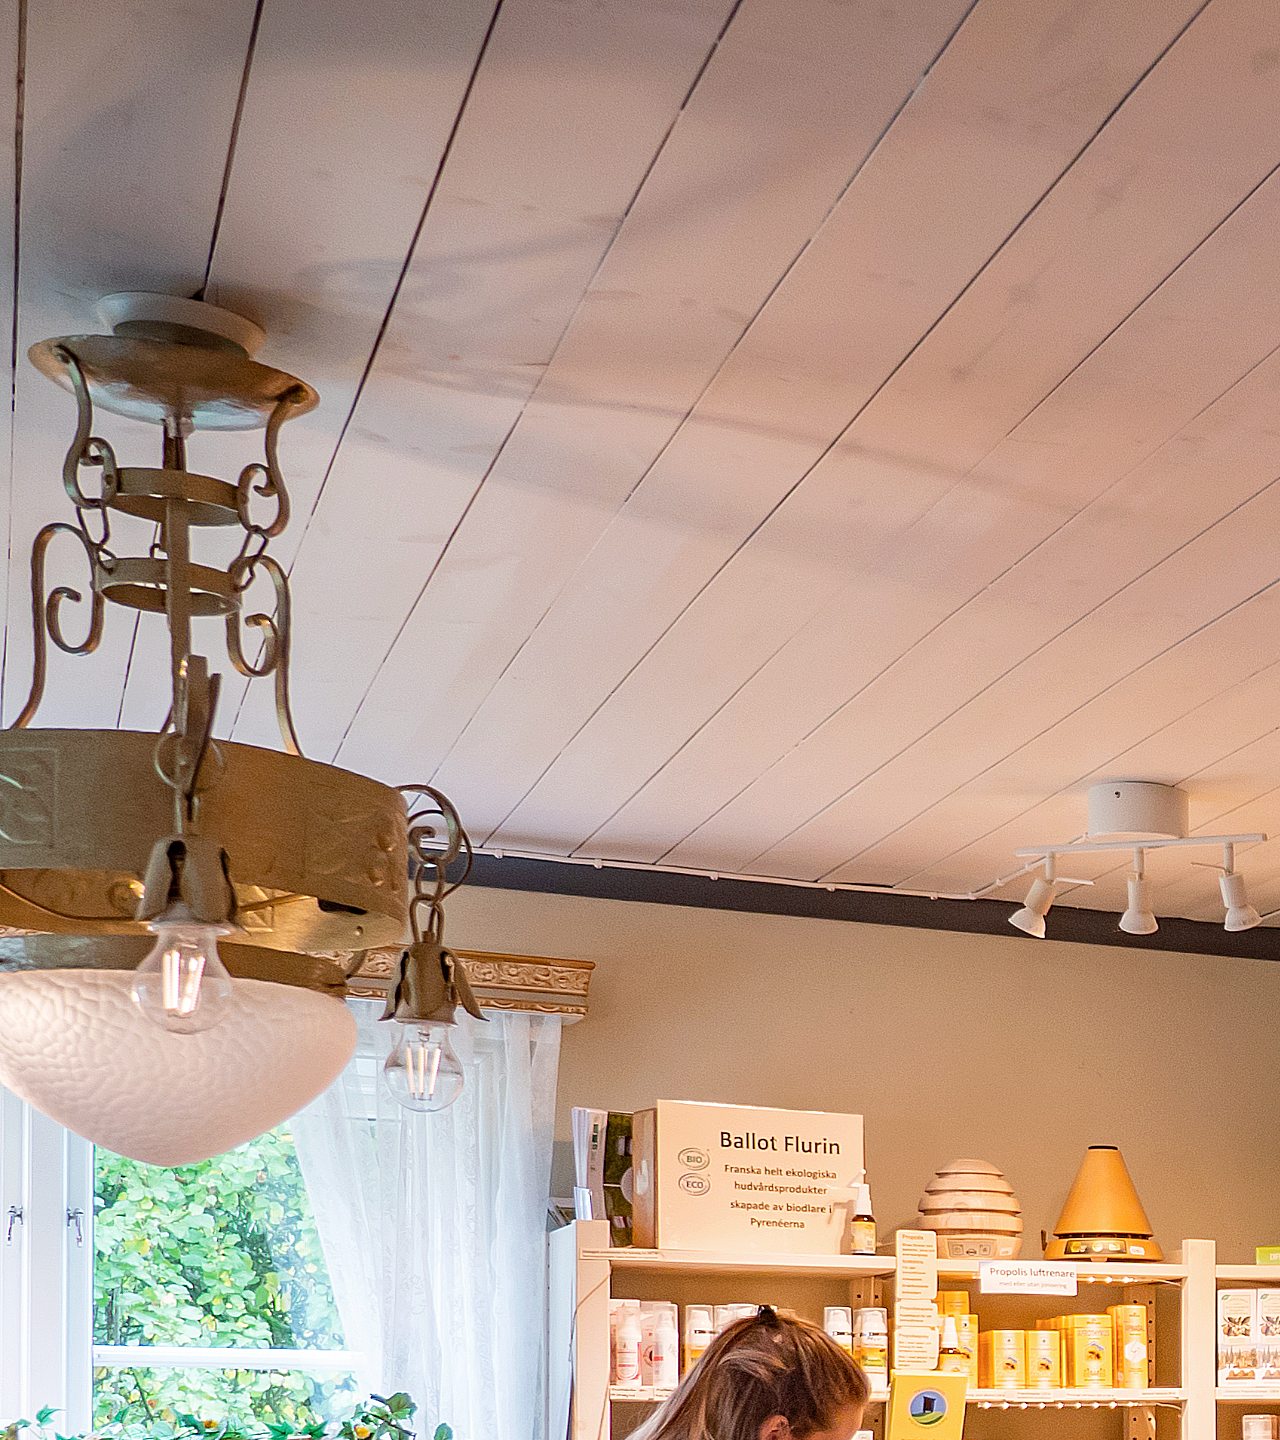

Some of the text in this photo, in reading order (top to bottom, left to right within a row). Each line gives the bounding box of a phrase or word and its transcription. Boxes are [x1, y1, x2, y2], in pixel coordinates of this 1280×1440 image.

[720, 1131, 841, 1155] Ballot Flurin
[686, 1154, 703, 1164] BIO
[724, 1164, 837, 1180] Franska helt ekologiska
[686, 1180, 704, 1189] ECO
[734, 1181, 828, 1195] hudvårdsprodukter
[730, 1201, 770, 1211] skapade
[786, 1203, 827, 1213] biodlare
[829, 1205, 832, 1214] i
[750, 1218, 805, 1229] Pyrenéerna
[989, 1267, 1076, 1278] Propolis luftrenare
